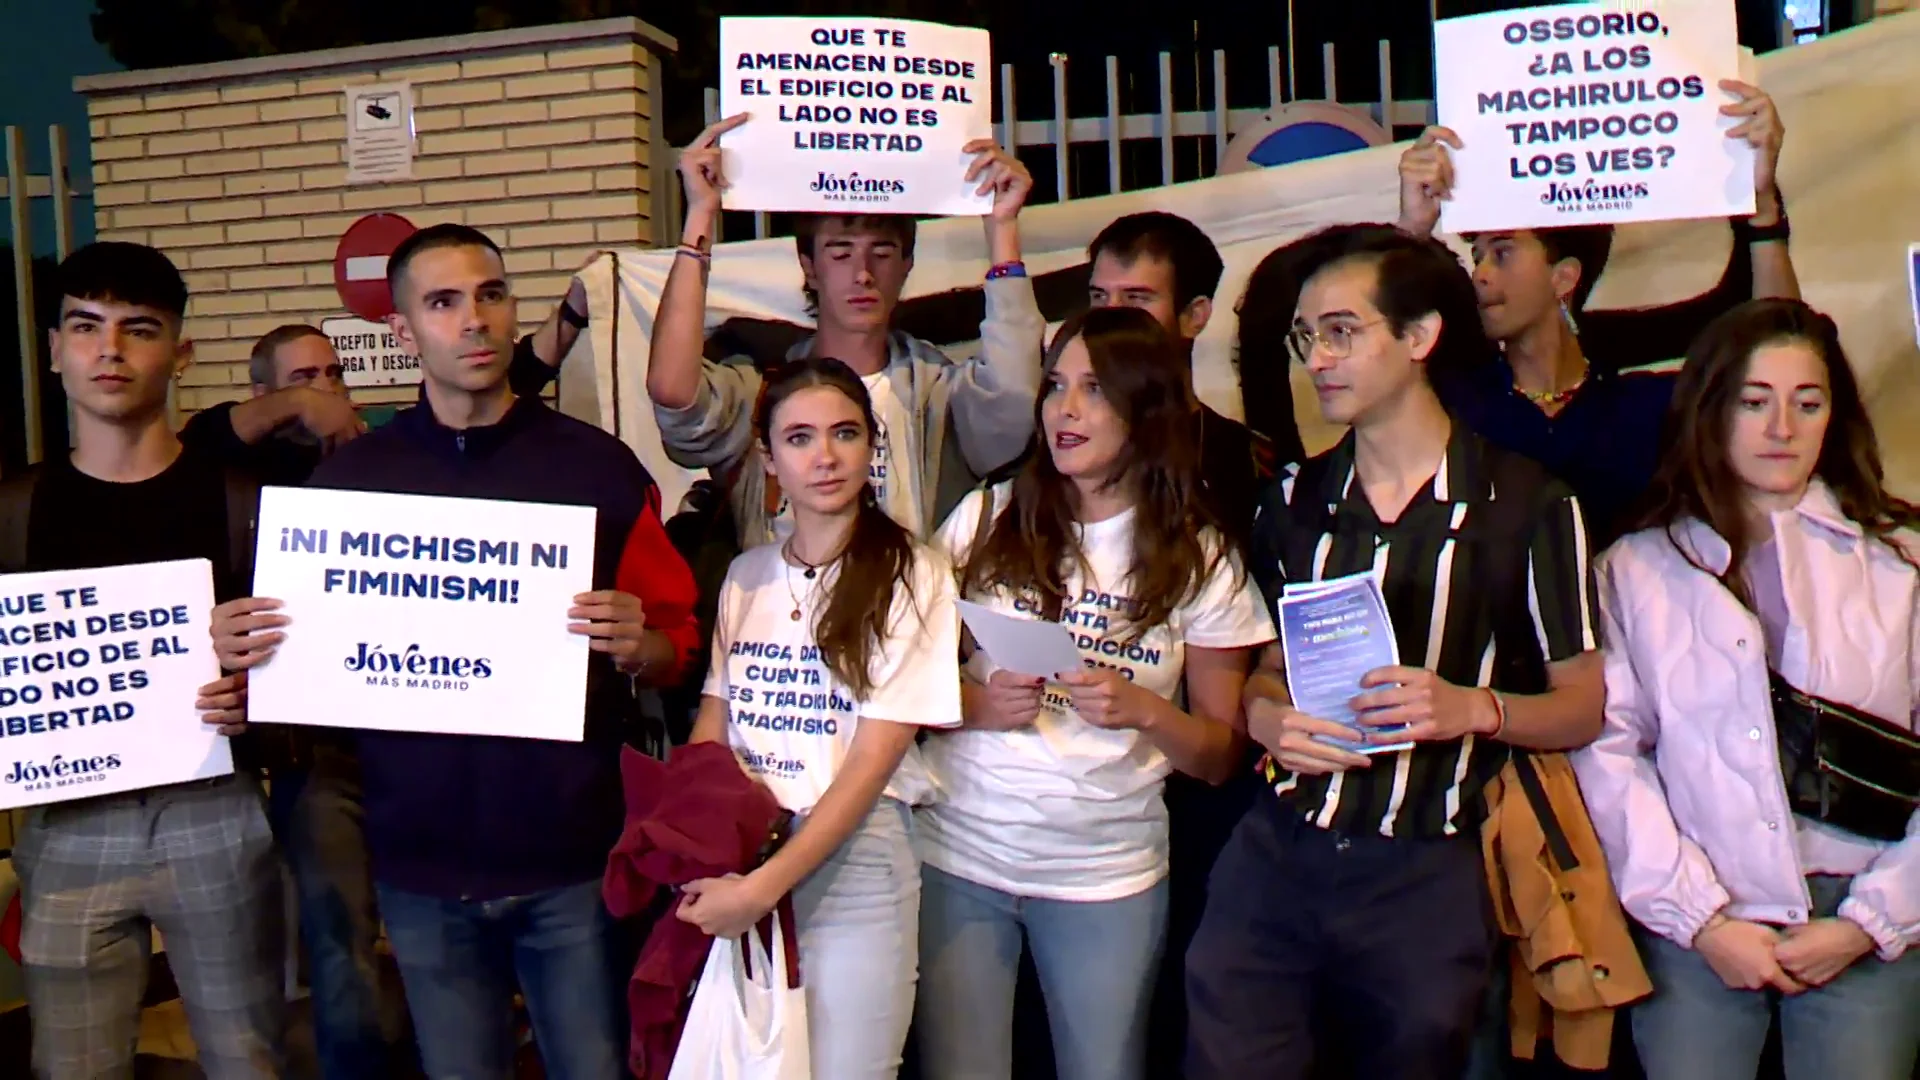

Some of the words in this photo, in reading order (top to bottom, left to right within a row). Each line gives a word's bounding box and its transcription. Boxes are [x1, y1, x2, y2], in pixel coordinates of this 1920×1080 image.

[811, 28, 865, 45] QUE
[874, 28, 906, 47] TE
[1503, 12, 1669, 44] OSSORIO,
[737, 53, 885, 72] AMENACEN
[894, 56, 975, 79] DESDE
[1528, 51, 1573, 76] ¿A
[1583, 45, 1651, 72] LOS
[740, 79, 771, 95] EL
[779, 79, 893, 99] EDIFICIO
[901, 83, 934, 100] DE
[942, 85, 973, 104] AL
[1477, 75, 1704, 114] MACHIRULOS
[779, 105, 852, 124] LADO
[860, 107, 898, 126] NO
[905, 108, 938, 127] ES
[1506, 111, 1679, 145] TAMPOCO
[794, 131, 923, 152] LIBERTAD
[1510, 152, 1576, 178] LOS
[1586, 145, 1675, 173] VES?
[810, 171, 904, 193] Jóvenes
[1540, 178, 1648, 204] Jóvenes
[1587, 201, 1632, 210] MADRID
[332, 333, 375, 351] XCEPTO
[370, 355, 377, 371] Y
[382, 354, 420, 371] DESCA
[280, 527, 328, 554] ¡NI
[340, 531, 519, 566] MICHISMI
[531, 543, 568, 569] NI
[324, 568, 519, 604] FIMINISMI!
[0, 593, 47, 617] UE
[56, 586, 98, 610] TE
[86, 605, 189, 636] DESDE
[0, 648, 90, 676] FICIO
[99, 641, 141, 664] DE
[151, 635, 189, 657] AL
[344, 642, 492, 679] Jóvenes
[800, 645, 818, 662] DA
[52, 676, 99, 700] NO
[108, 670, 149, 692] ES
[406, 677, 469, 691] MADRID
[745, 664, 820, 685] CUENTA
[5, 754, 121, 783] Jóvenes
[56, 773, 106, 786] MADRID
